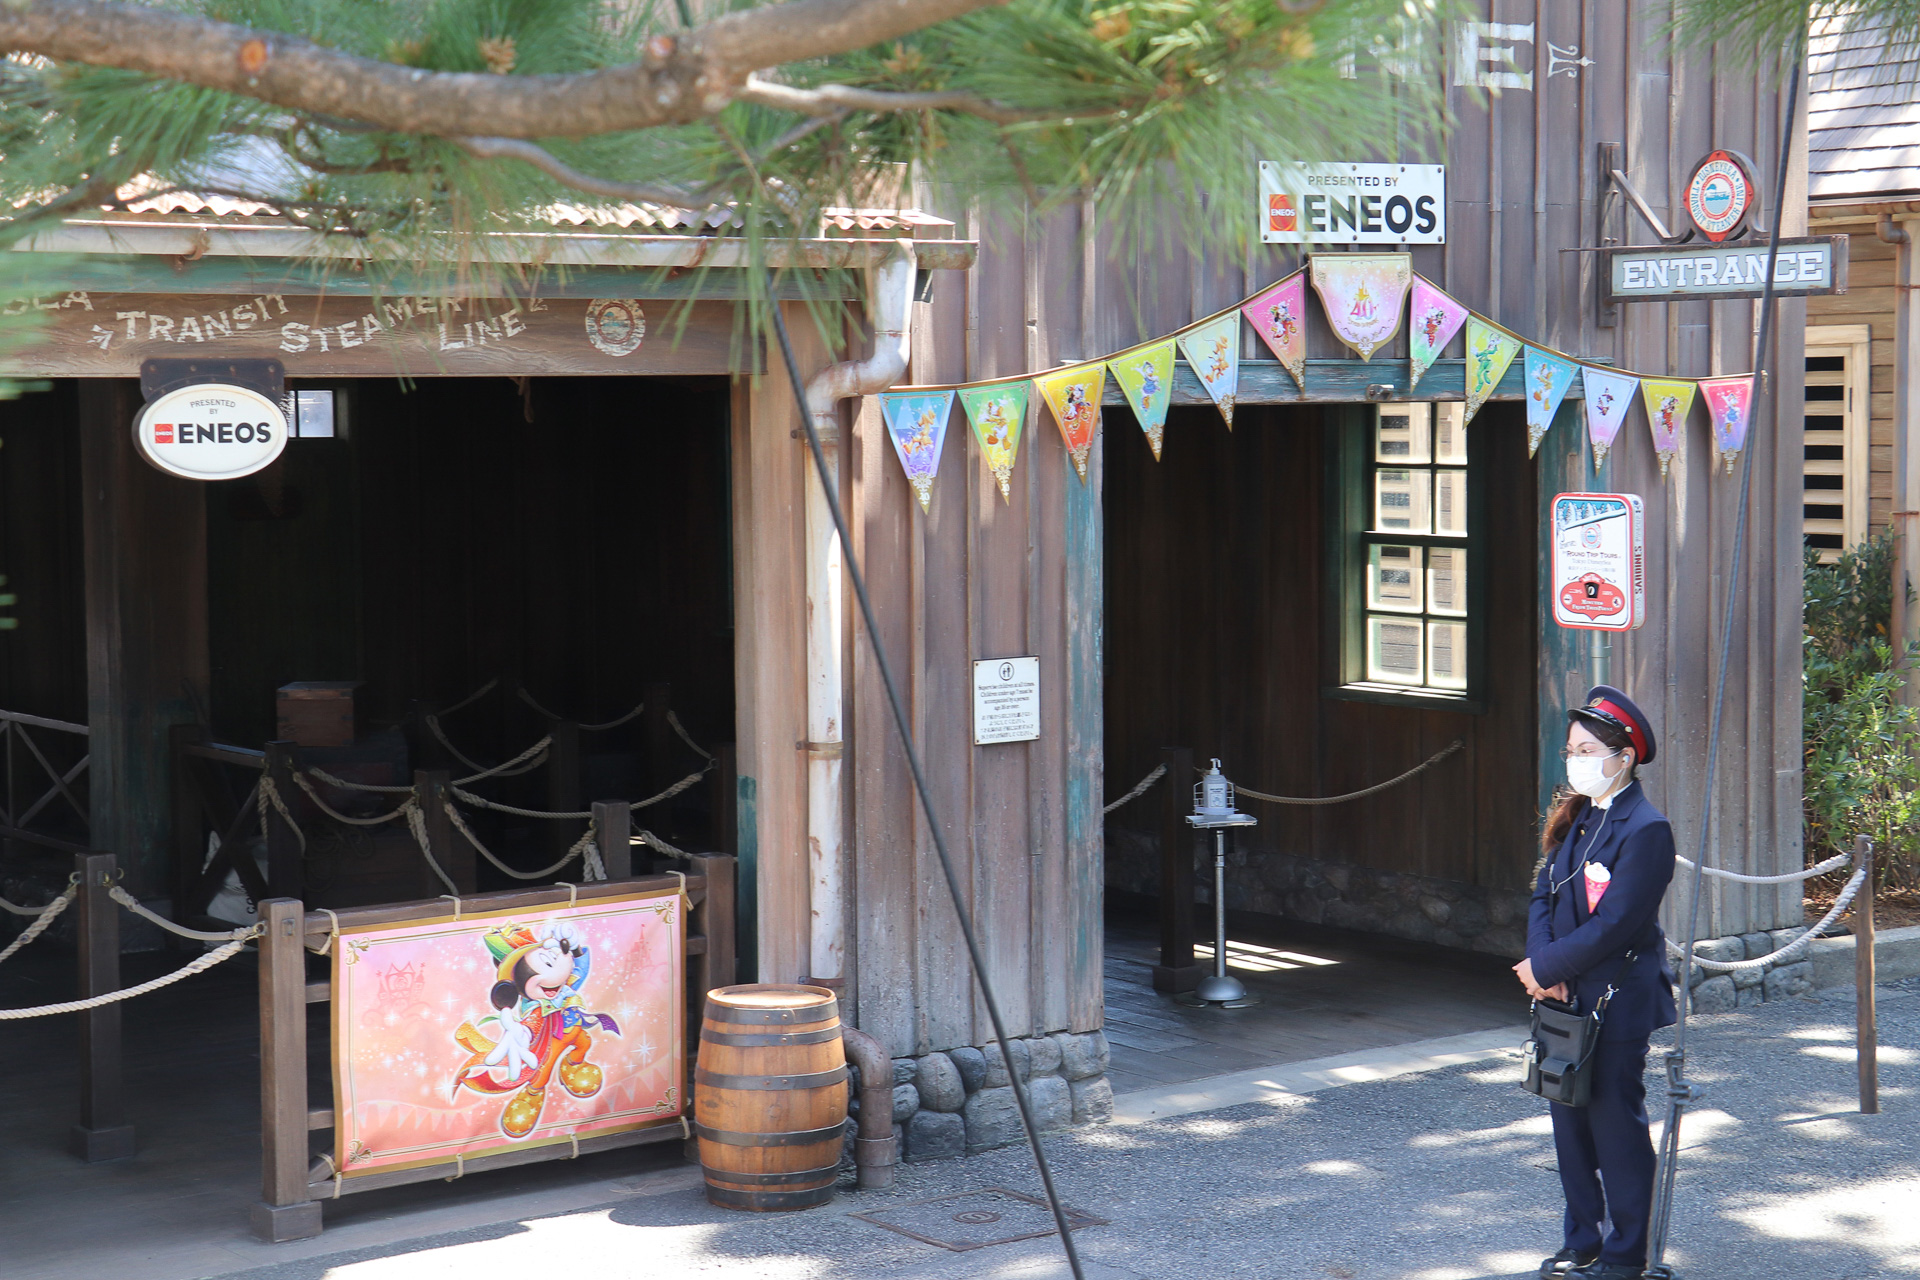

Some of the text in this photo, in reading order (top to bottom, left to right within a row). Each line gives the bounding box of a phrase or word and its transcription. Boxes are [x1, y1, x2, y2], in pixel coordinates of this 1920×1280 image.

[1308, 175, 1399, 187] PRESENTED BY
[1270, 208, 1296, 217] ENEOS
[1304, 194, 1437, 234] ENEOS
[1622, 250, 1824, 290] ENTRANCE
[435, 308, 528, 350] LINE
[190, 399, 236, 409] PRESENTED
[179, 422, 271, 444] ENEOS
[1587, 551, 1599, 559] TRIP
